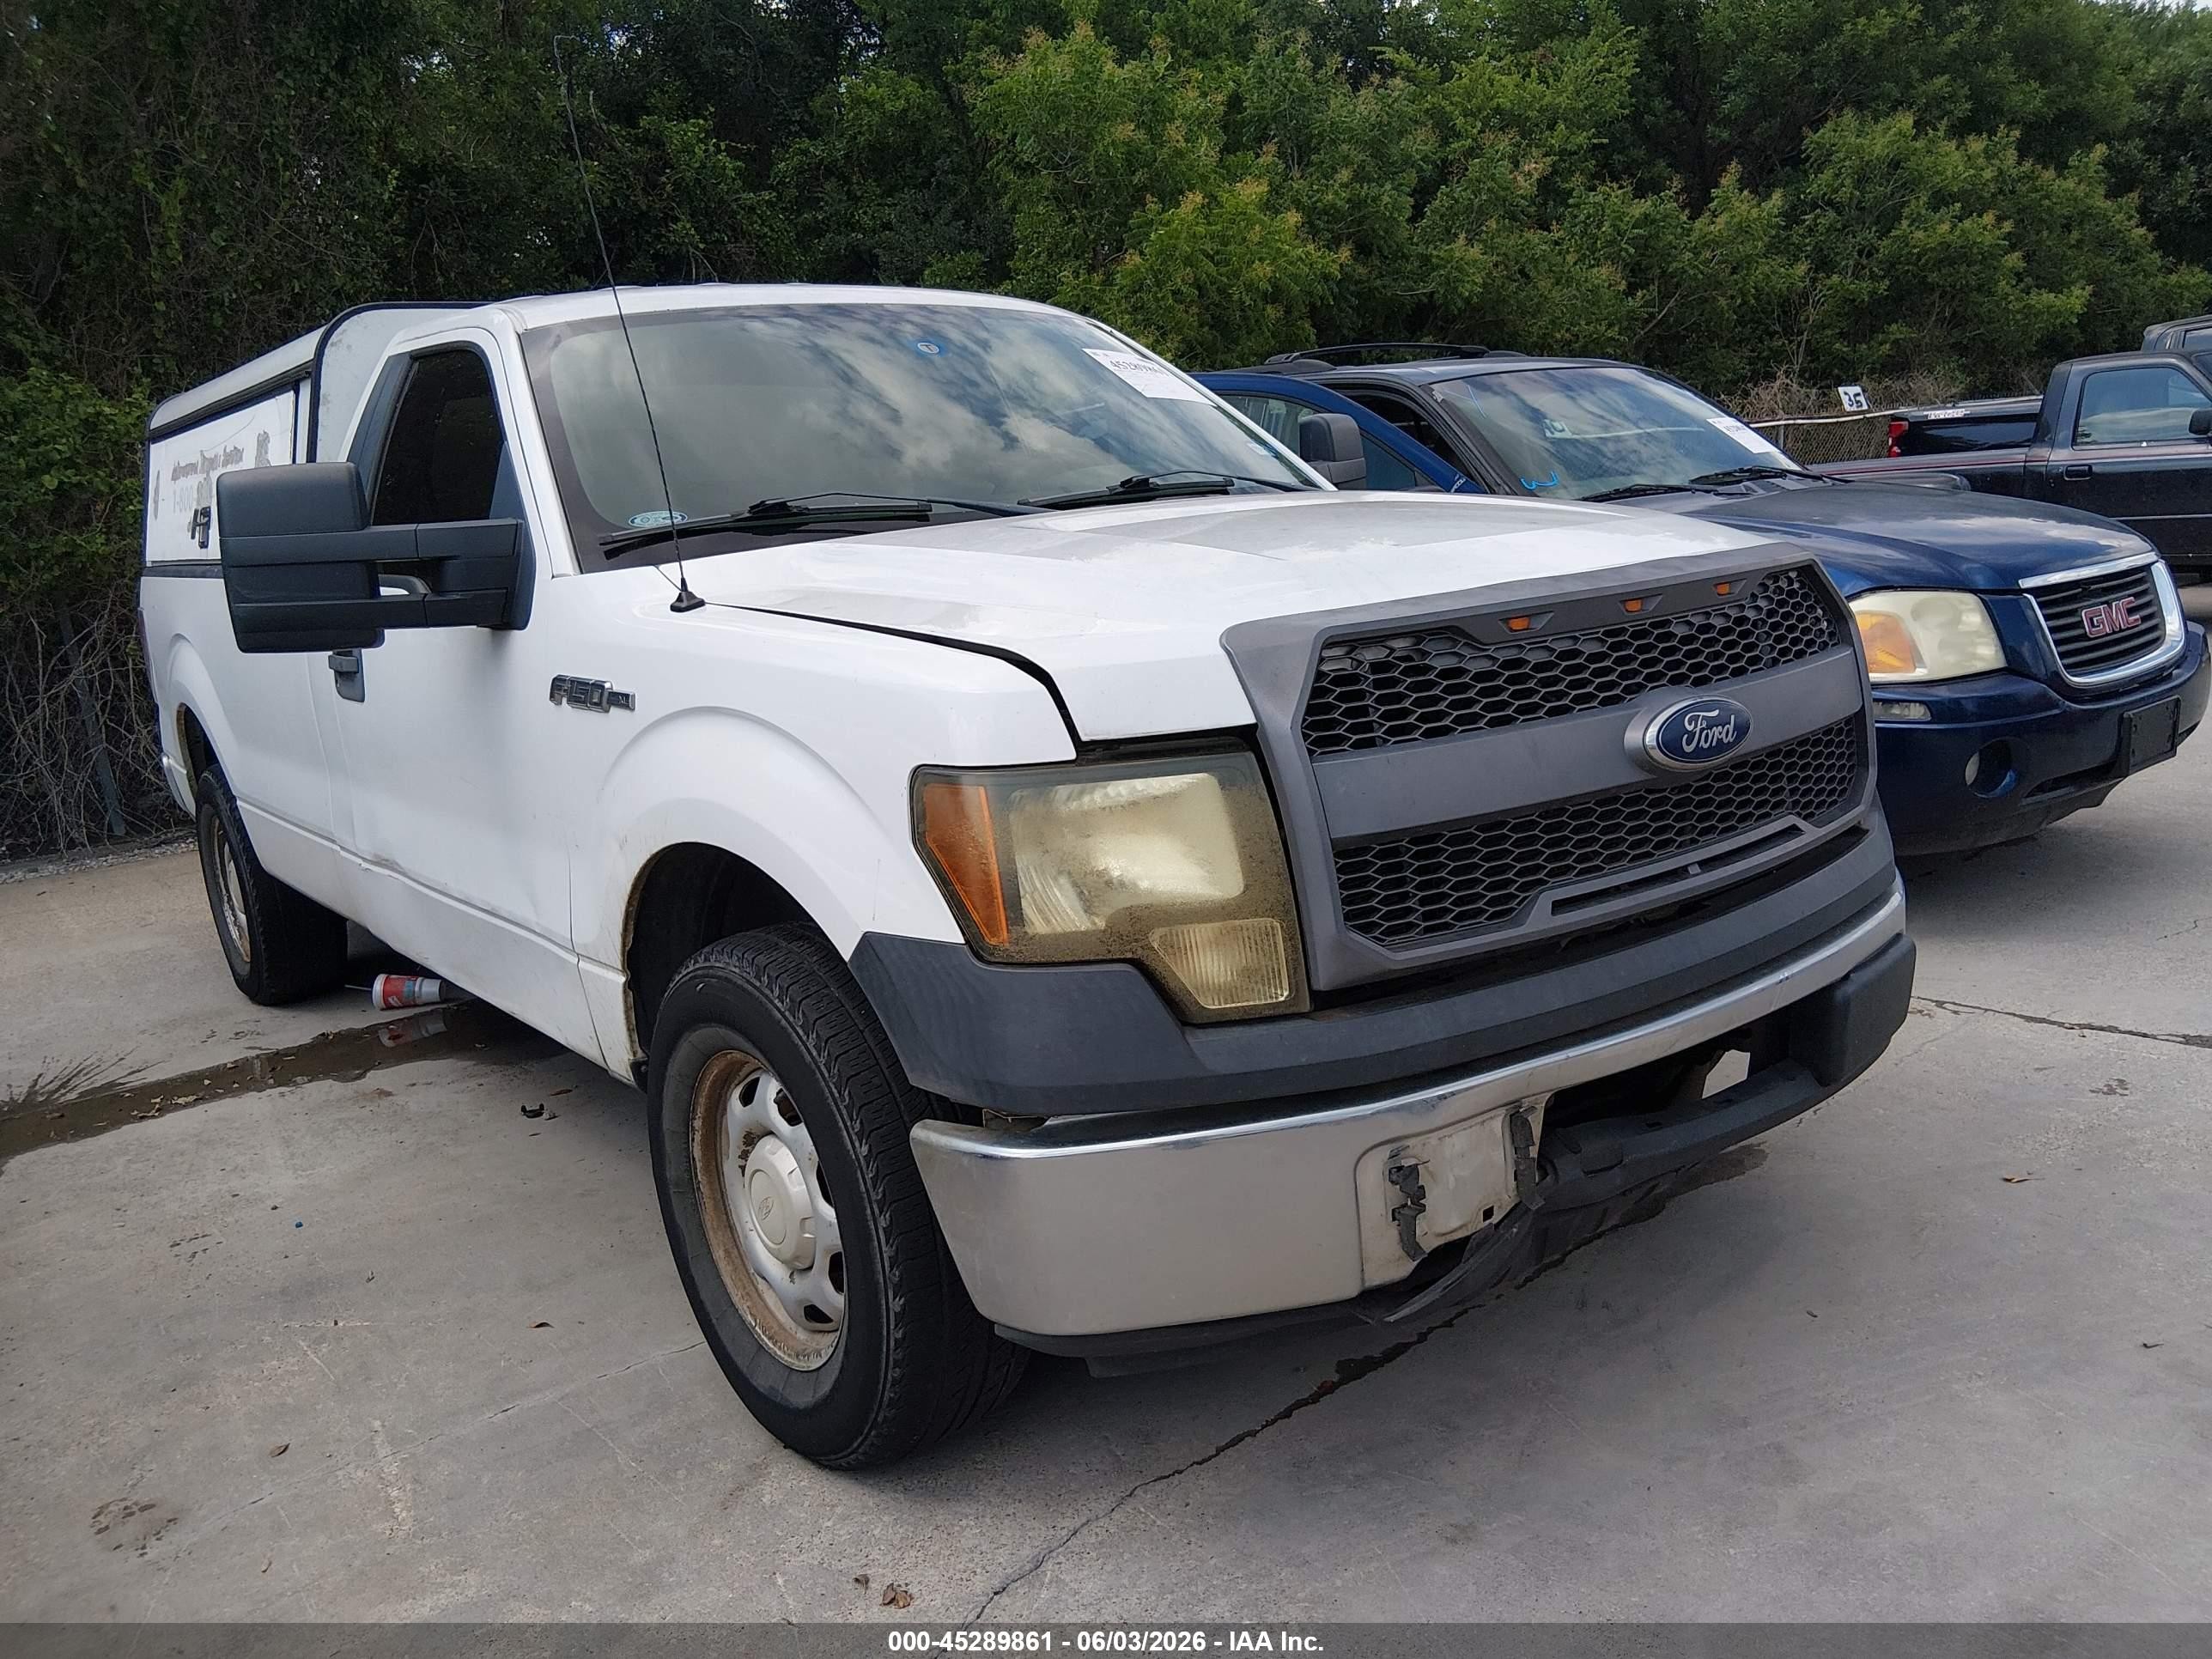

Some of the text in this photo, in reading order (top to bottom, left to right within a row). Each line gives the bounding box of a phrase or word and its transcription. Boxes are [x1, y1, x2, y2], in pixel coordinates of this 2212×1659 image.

[1844, 391, 1863, 408] 35
[2081, 596, 2142, 638] GMC
[1681, 709, 1737, 752] Ford
